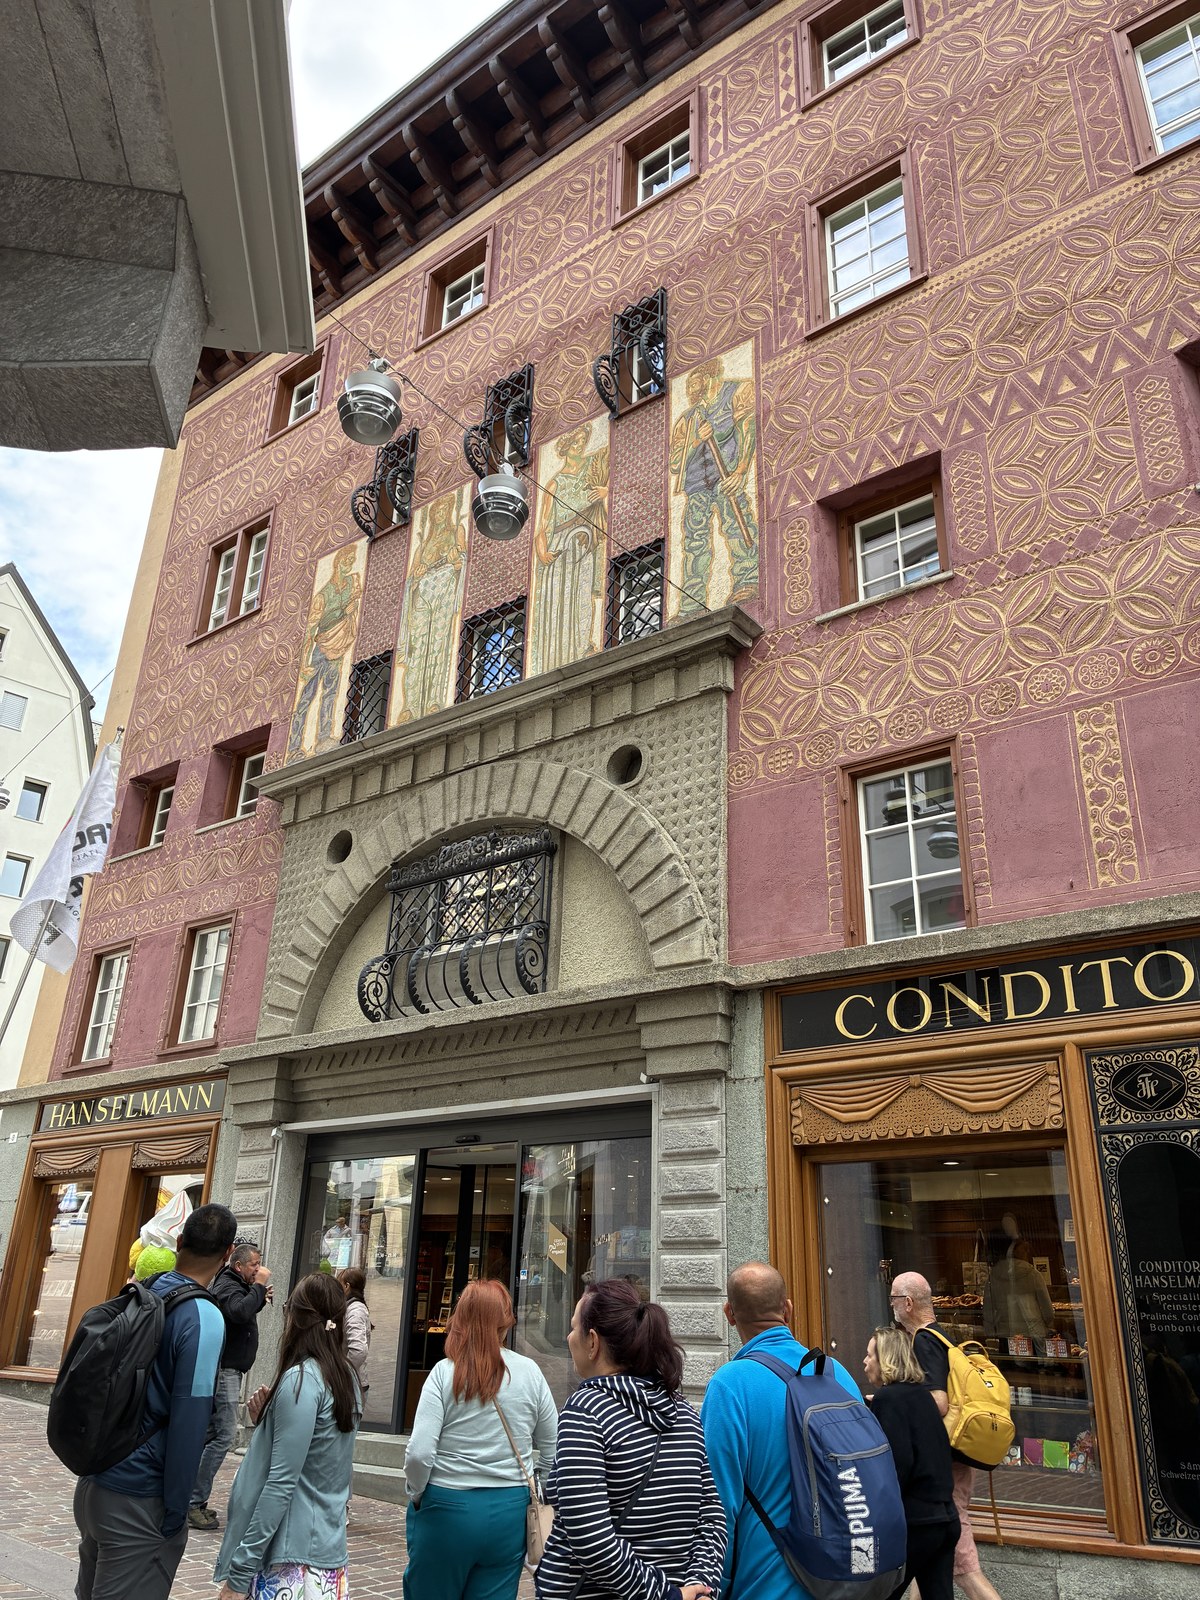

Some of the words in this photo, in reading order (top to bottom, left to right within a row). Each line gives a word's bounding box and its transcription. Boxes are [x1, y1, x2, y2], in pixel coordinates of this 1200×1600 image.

[834, 949, 1195, 1040] CONDITO
[48, 1083, 215, 1129] HANSELMANN
[837, 1466, 874, 1535] PUMA
